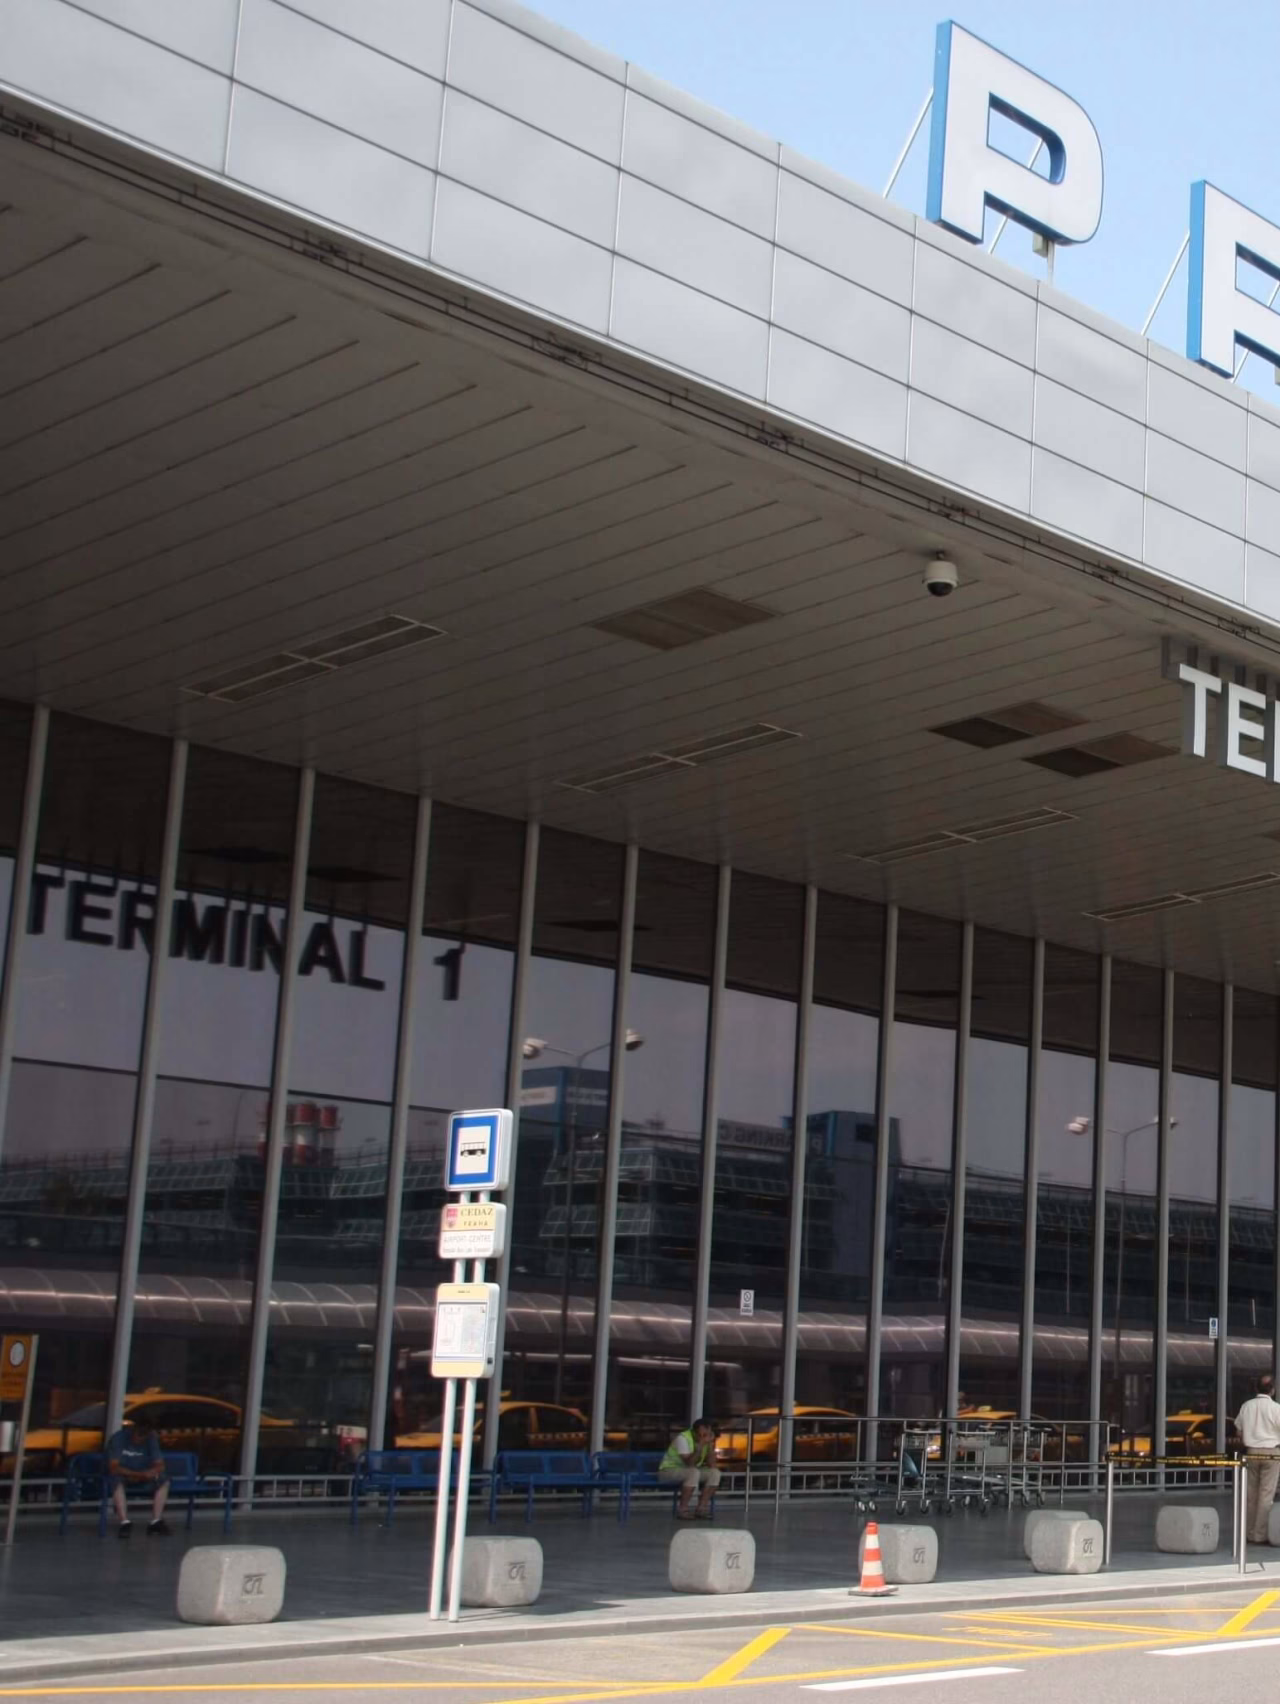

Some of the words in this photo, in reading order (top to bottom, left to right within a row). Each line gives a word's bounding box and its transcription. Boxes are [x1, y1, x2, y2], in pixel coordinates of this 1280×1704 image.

[26, 872, 386, 991] TERMINAL
[433, 946, 464, 1001] 1
[461, 1207, 493, 1217] CEDAZ
